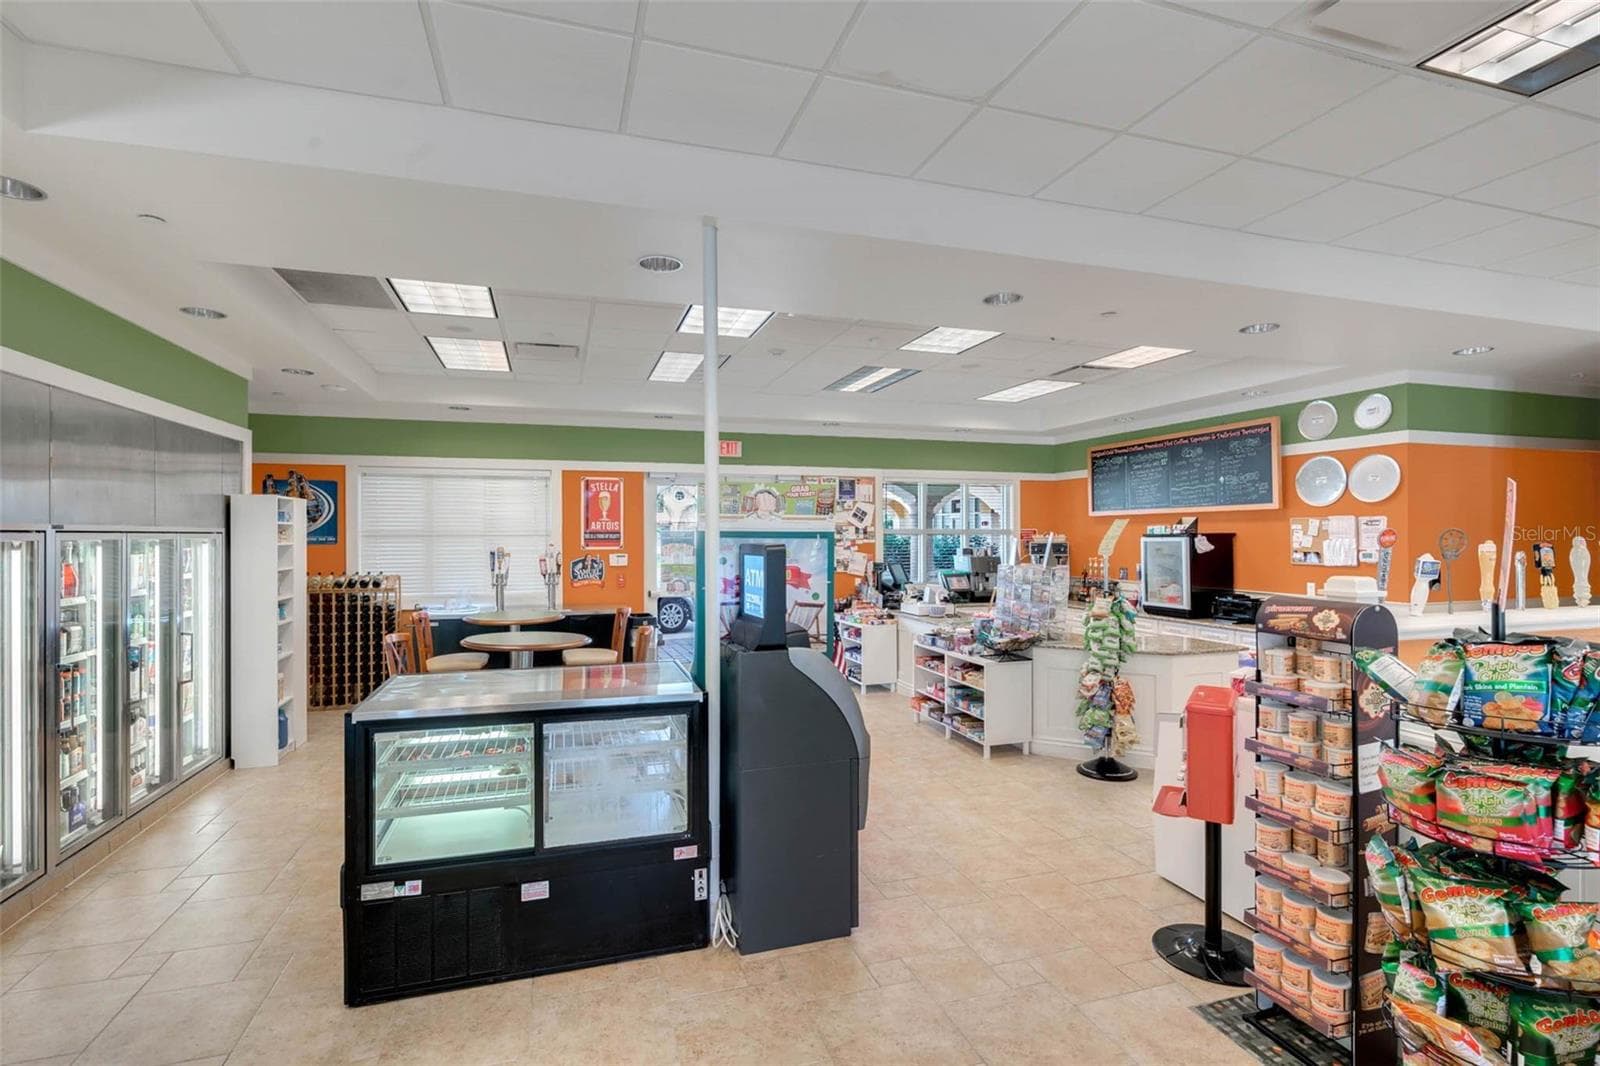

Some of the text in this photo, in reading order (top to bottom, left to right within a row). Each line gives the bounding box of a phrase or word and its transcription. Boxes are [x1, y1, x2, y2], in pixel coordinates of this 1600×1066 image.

[720, 442, 737, 455] EXIT
[590, 482, 619, 492] STELLA
[591, 521, 620, 530] ARTOIS
[745, 568, 764, 588] ATM
[1509, 683, 1538, 691] Plantain
